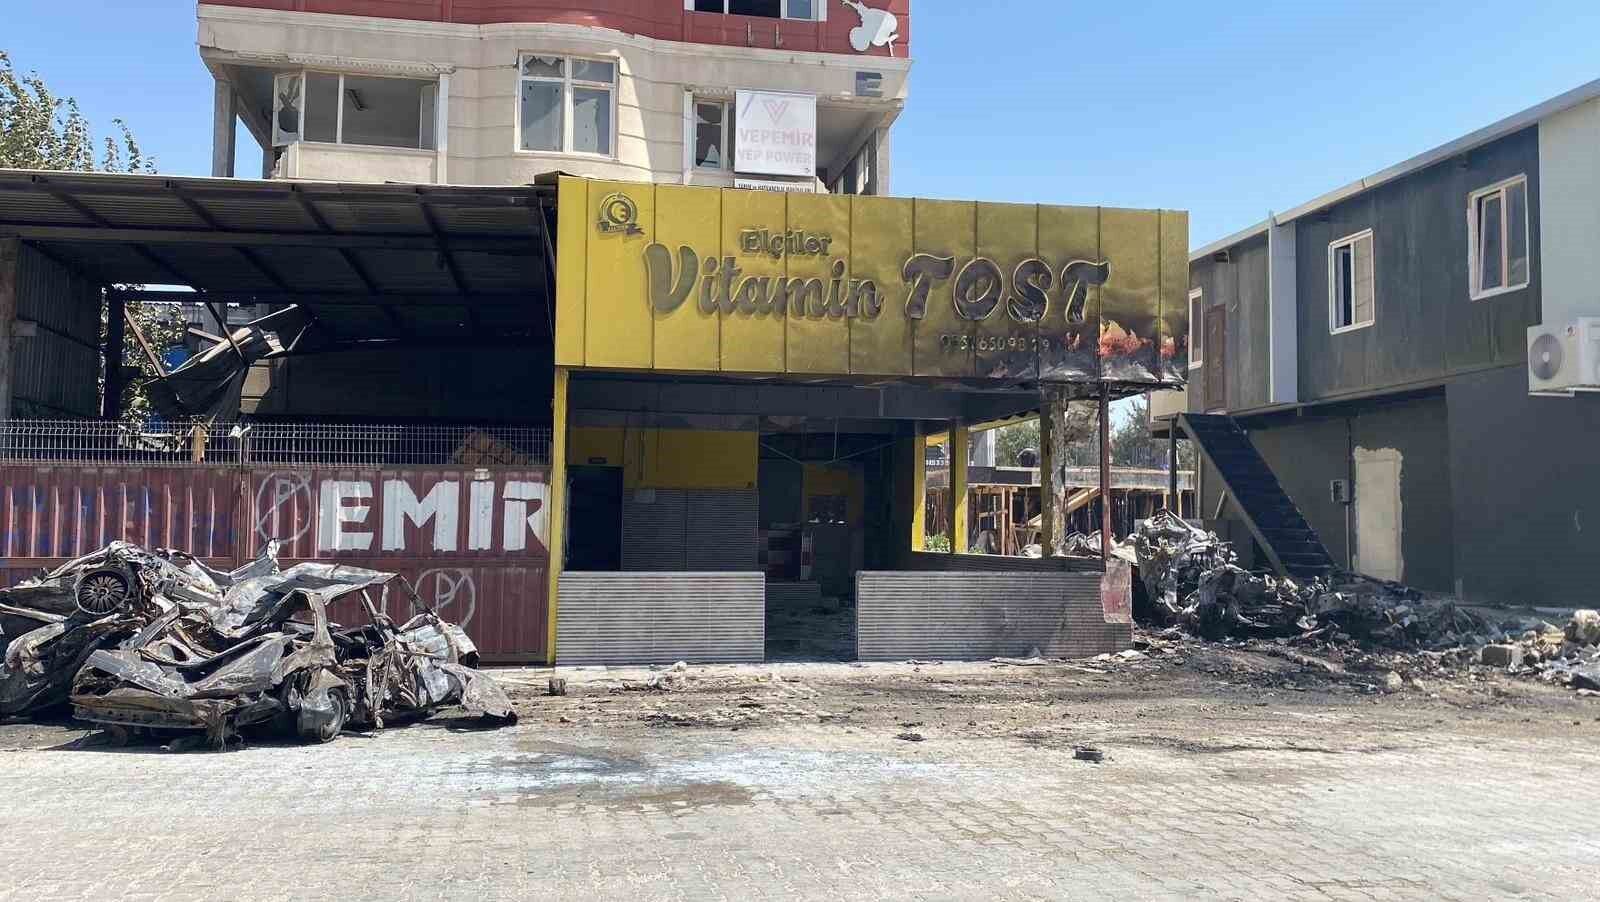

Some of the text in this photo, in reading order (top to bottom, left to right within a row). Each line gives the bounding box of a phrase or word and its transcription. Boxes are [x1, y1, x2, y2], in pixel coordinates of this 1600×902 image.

[643, 242, 1111, 323] Vitamin TOST
[738, 227, 832, 259] Elçiler
[318, 469, 549, 552] EMİR
